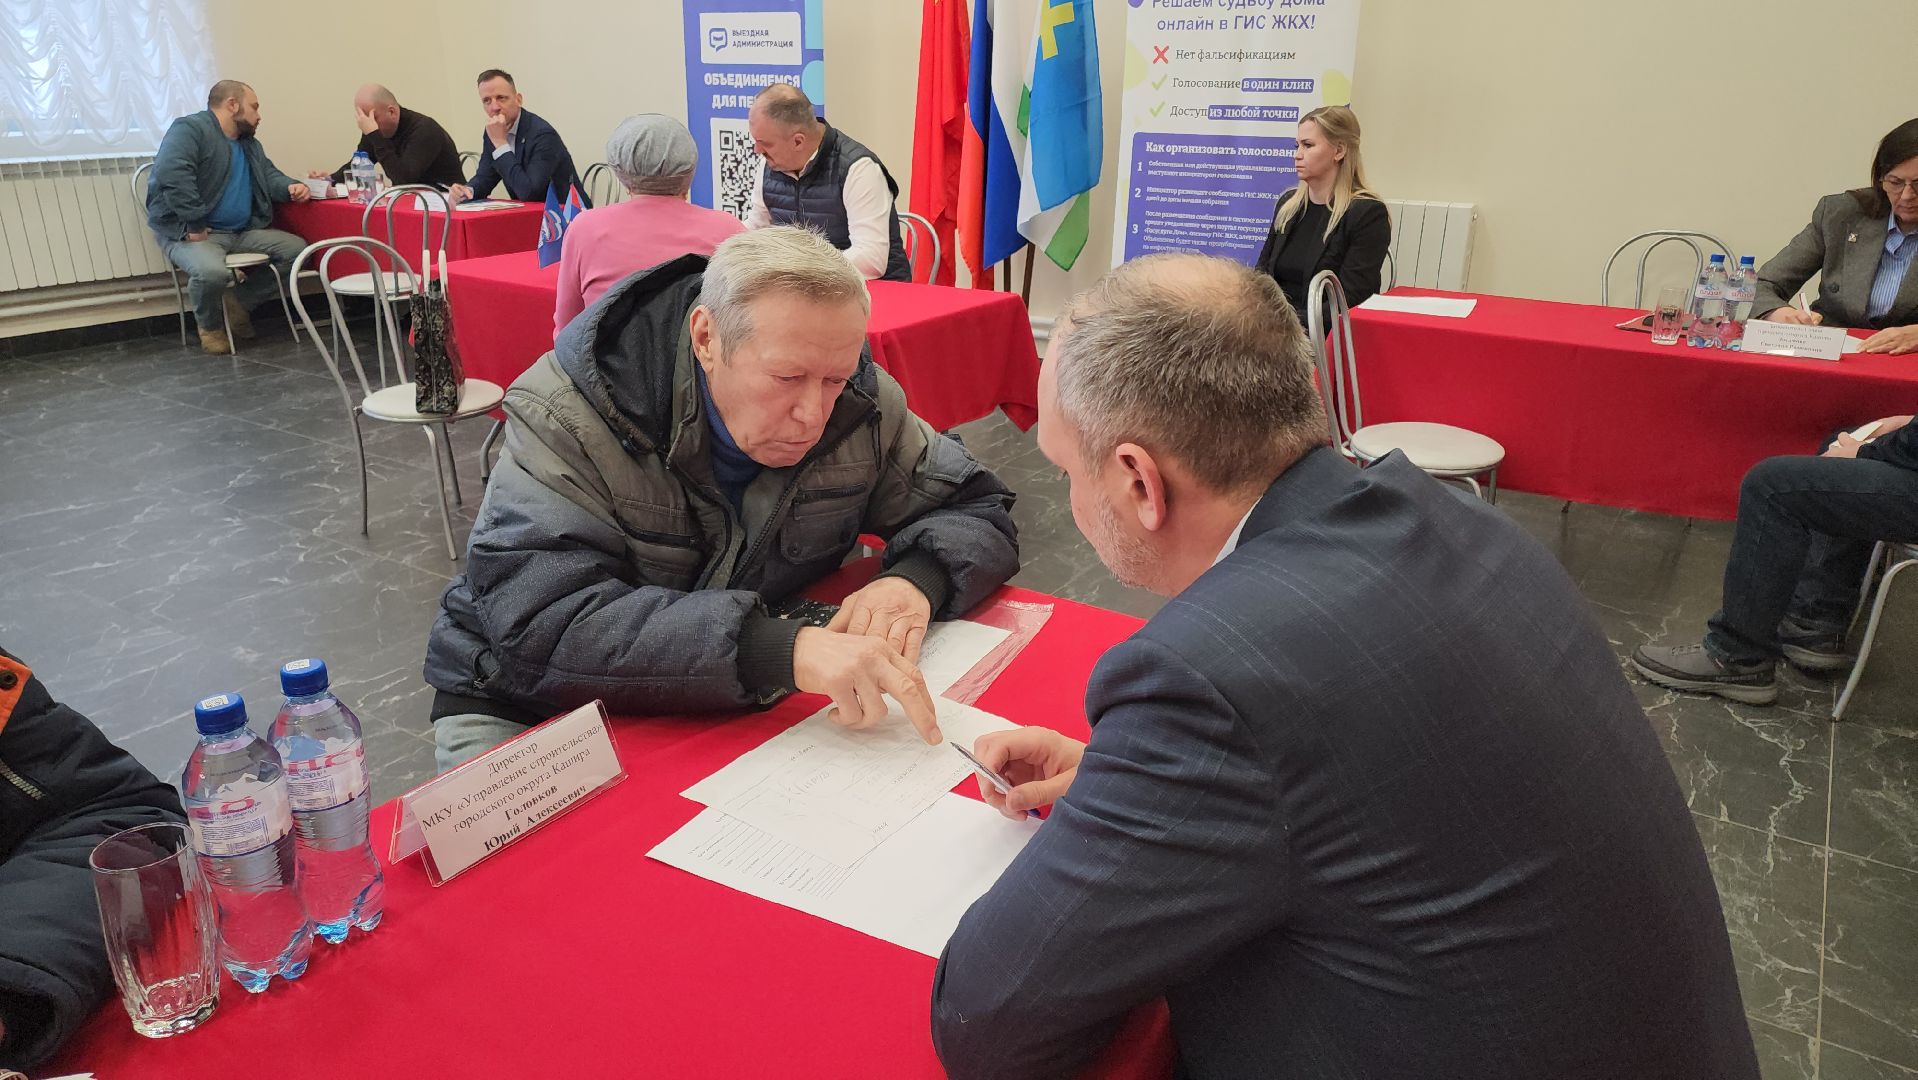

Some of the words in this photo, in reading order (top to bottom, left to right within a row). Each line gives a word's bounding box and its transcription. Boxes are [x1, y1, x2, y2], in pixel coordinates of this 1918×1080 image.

[1157, 16, 1214, 30] онлайн
[1219, 19, 1228, 30] в
[1233, 15, 1266, 30] ГИС
[1272, 14, 1316, 30] ЖКХ!
[1176, 50, 1195, 60] Нет
[1197, 49, 1296, 63] фальсификациям
[704, 73, 800, 88] ОБЪЕДИНЯЕМСЯ
[1172, 78, 1241, 89] Голосование
[1243, 80, 1249, 89] в
[1251, 80, 1280, 91] один
[1282, 80, 1312, 90] клик
[712, 94, 736, 109] ДЛЯ
[1170, 106, 1207, 118] Доступ
[1209, 108, 1222, 118] из
[1224, 106, 1261, 118] любой
[1263, 109, 1297, 119] точки
[1145, 141, 1164, 152] Как
[1165, 144, 1236, 157] организовать
[1137, 162, 1143, 172] 1
[1134, 188, 1141, 198] 2
[1132, 224, 1138, 234] 3
[488, 741, 538, 777] Директор
[422, 808, 453, 831] МКУ
[456, 765, 527, 814] «Управление
[531, 723, 603, 771] строительства»
[454, 793, 515, 833] городского
[517, 771, 551, 800] округа
[551, 748, 591, 775] Кашира
[505, 785, 558, 821] Головков
[484, 823, 520, 852] Юрий
[526, 785, 587, 827] Алексеевич
